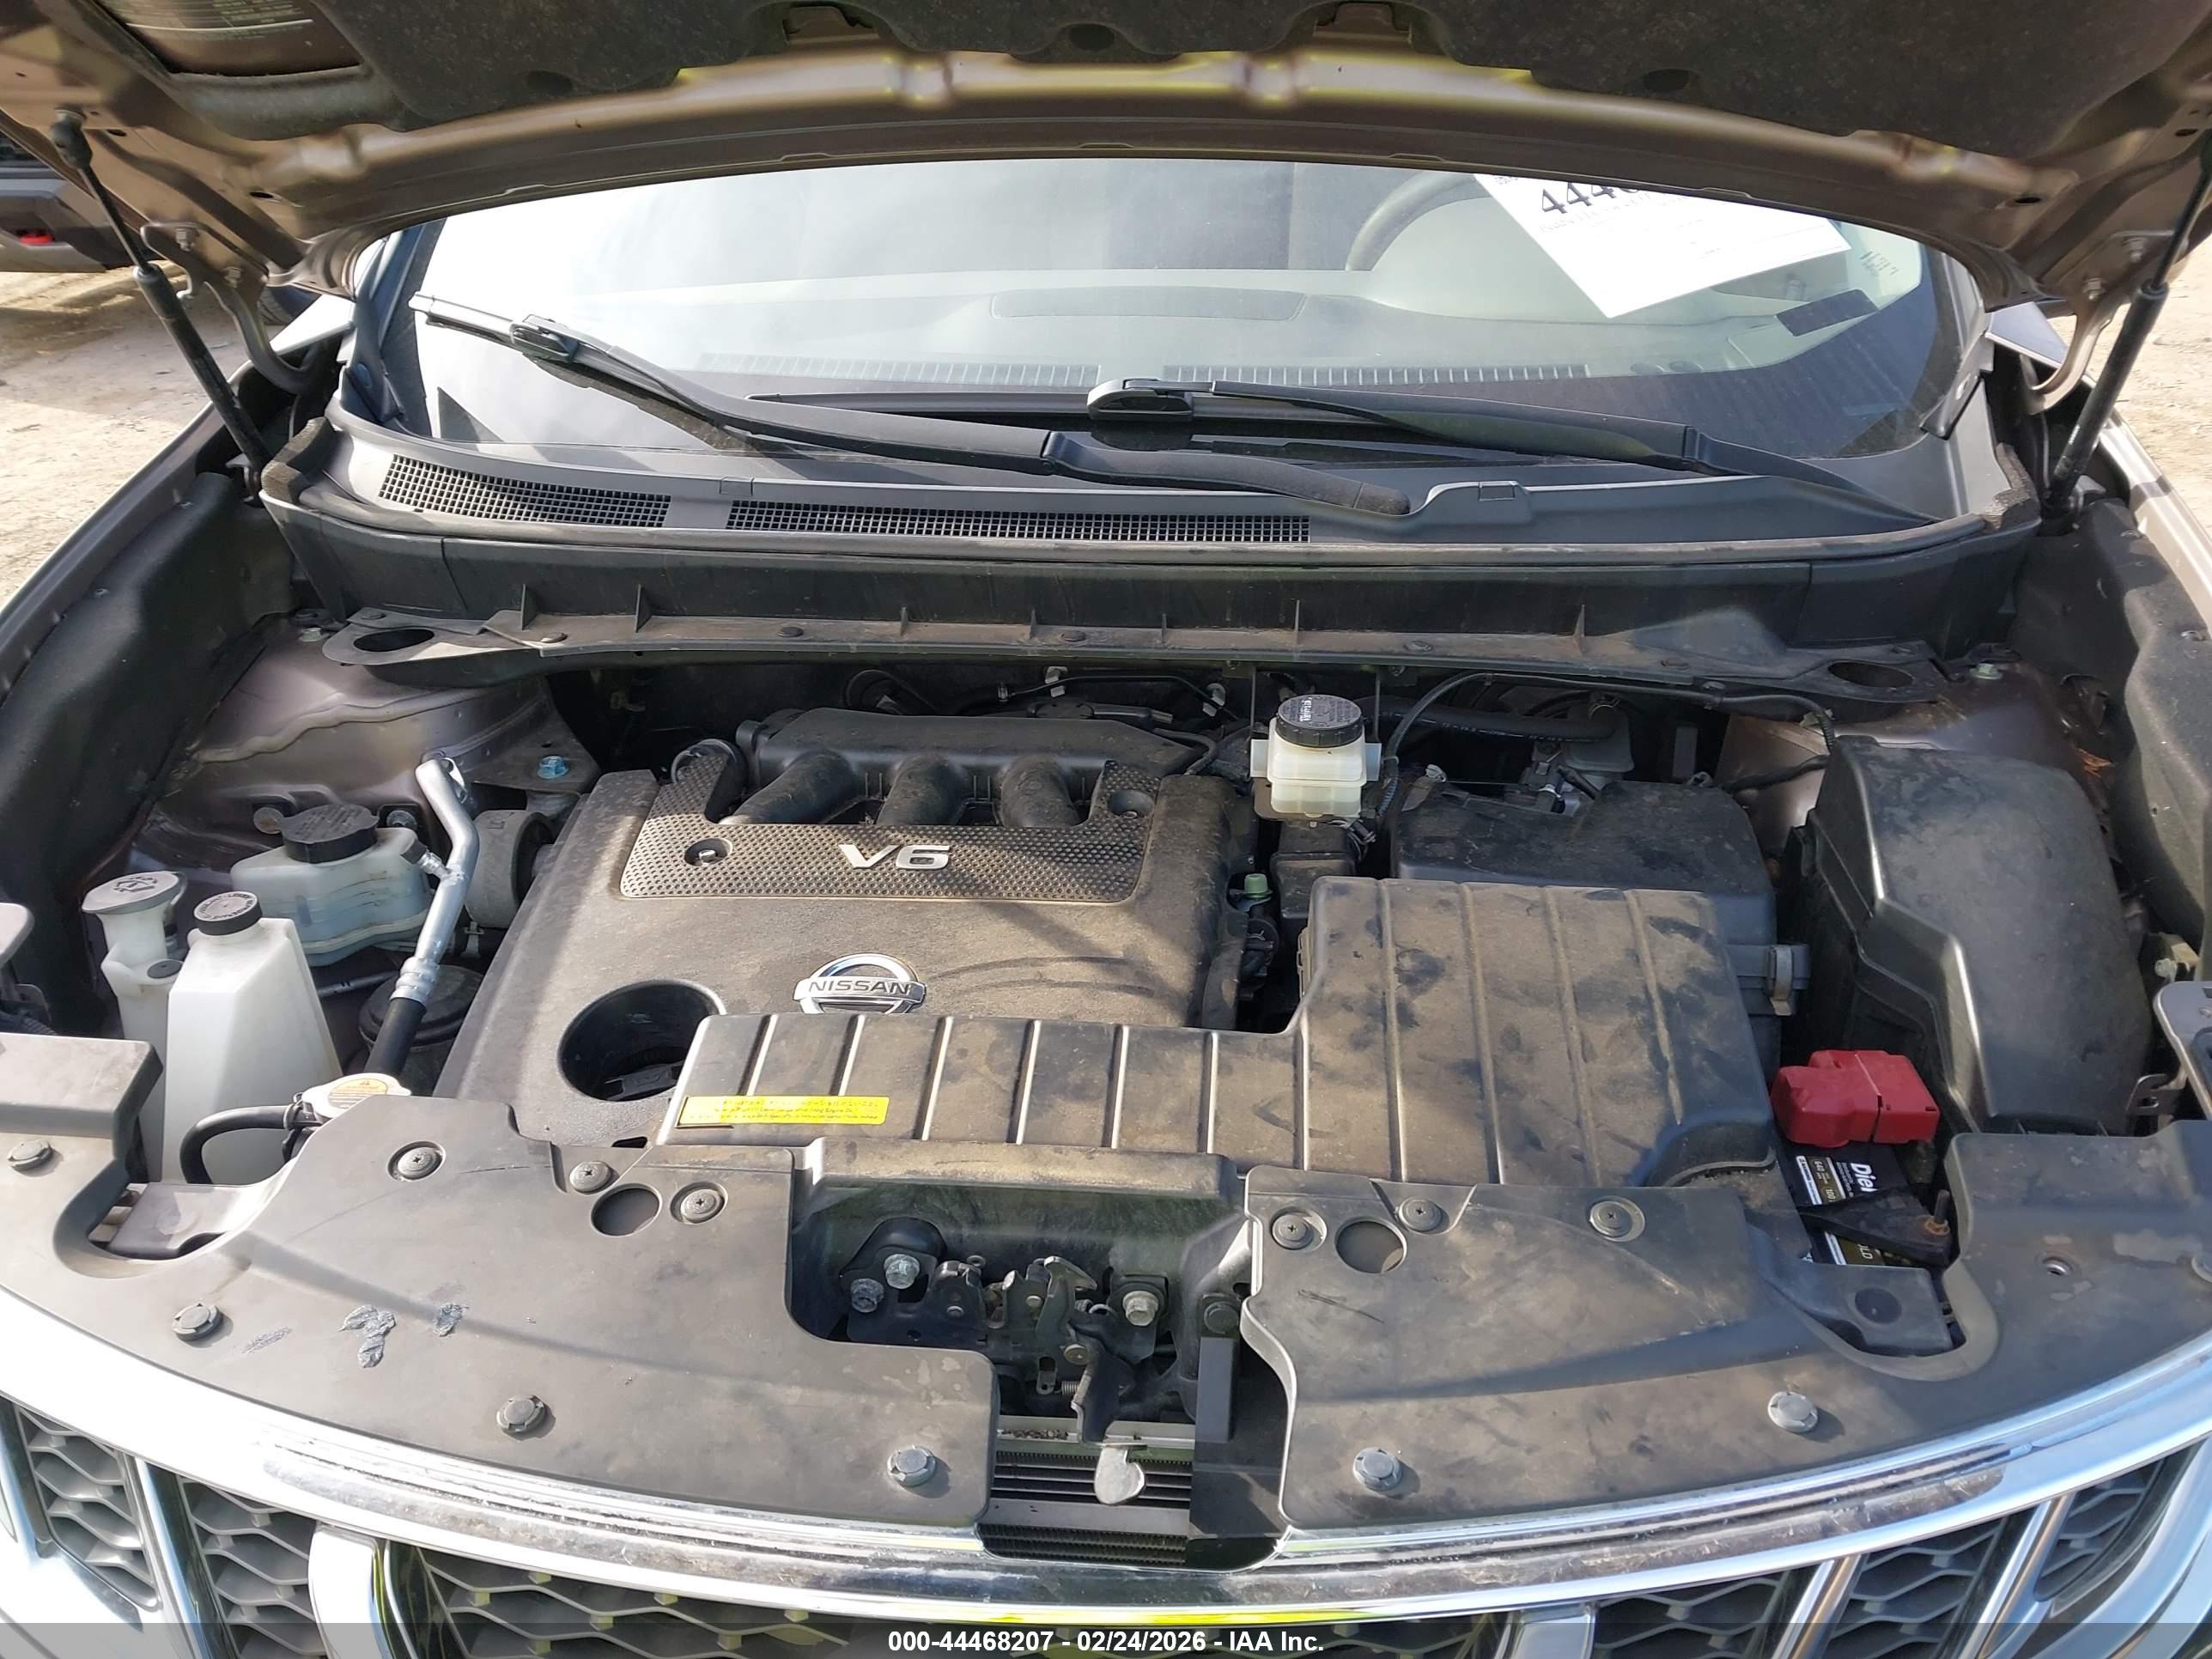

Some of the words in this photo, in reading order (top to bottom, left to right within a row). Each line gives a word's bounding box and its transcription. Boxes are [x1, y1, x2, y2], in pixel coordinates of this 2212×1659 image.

[1542, 182, 1638, 215] 444
[838, 844, 950, 869] V6
[809, 980, 910, 995] NISSAN
